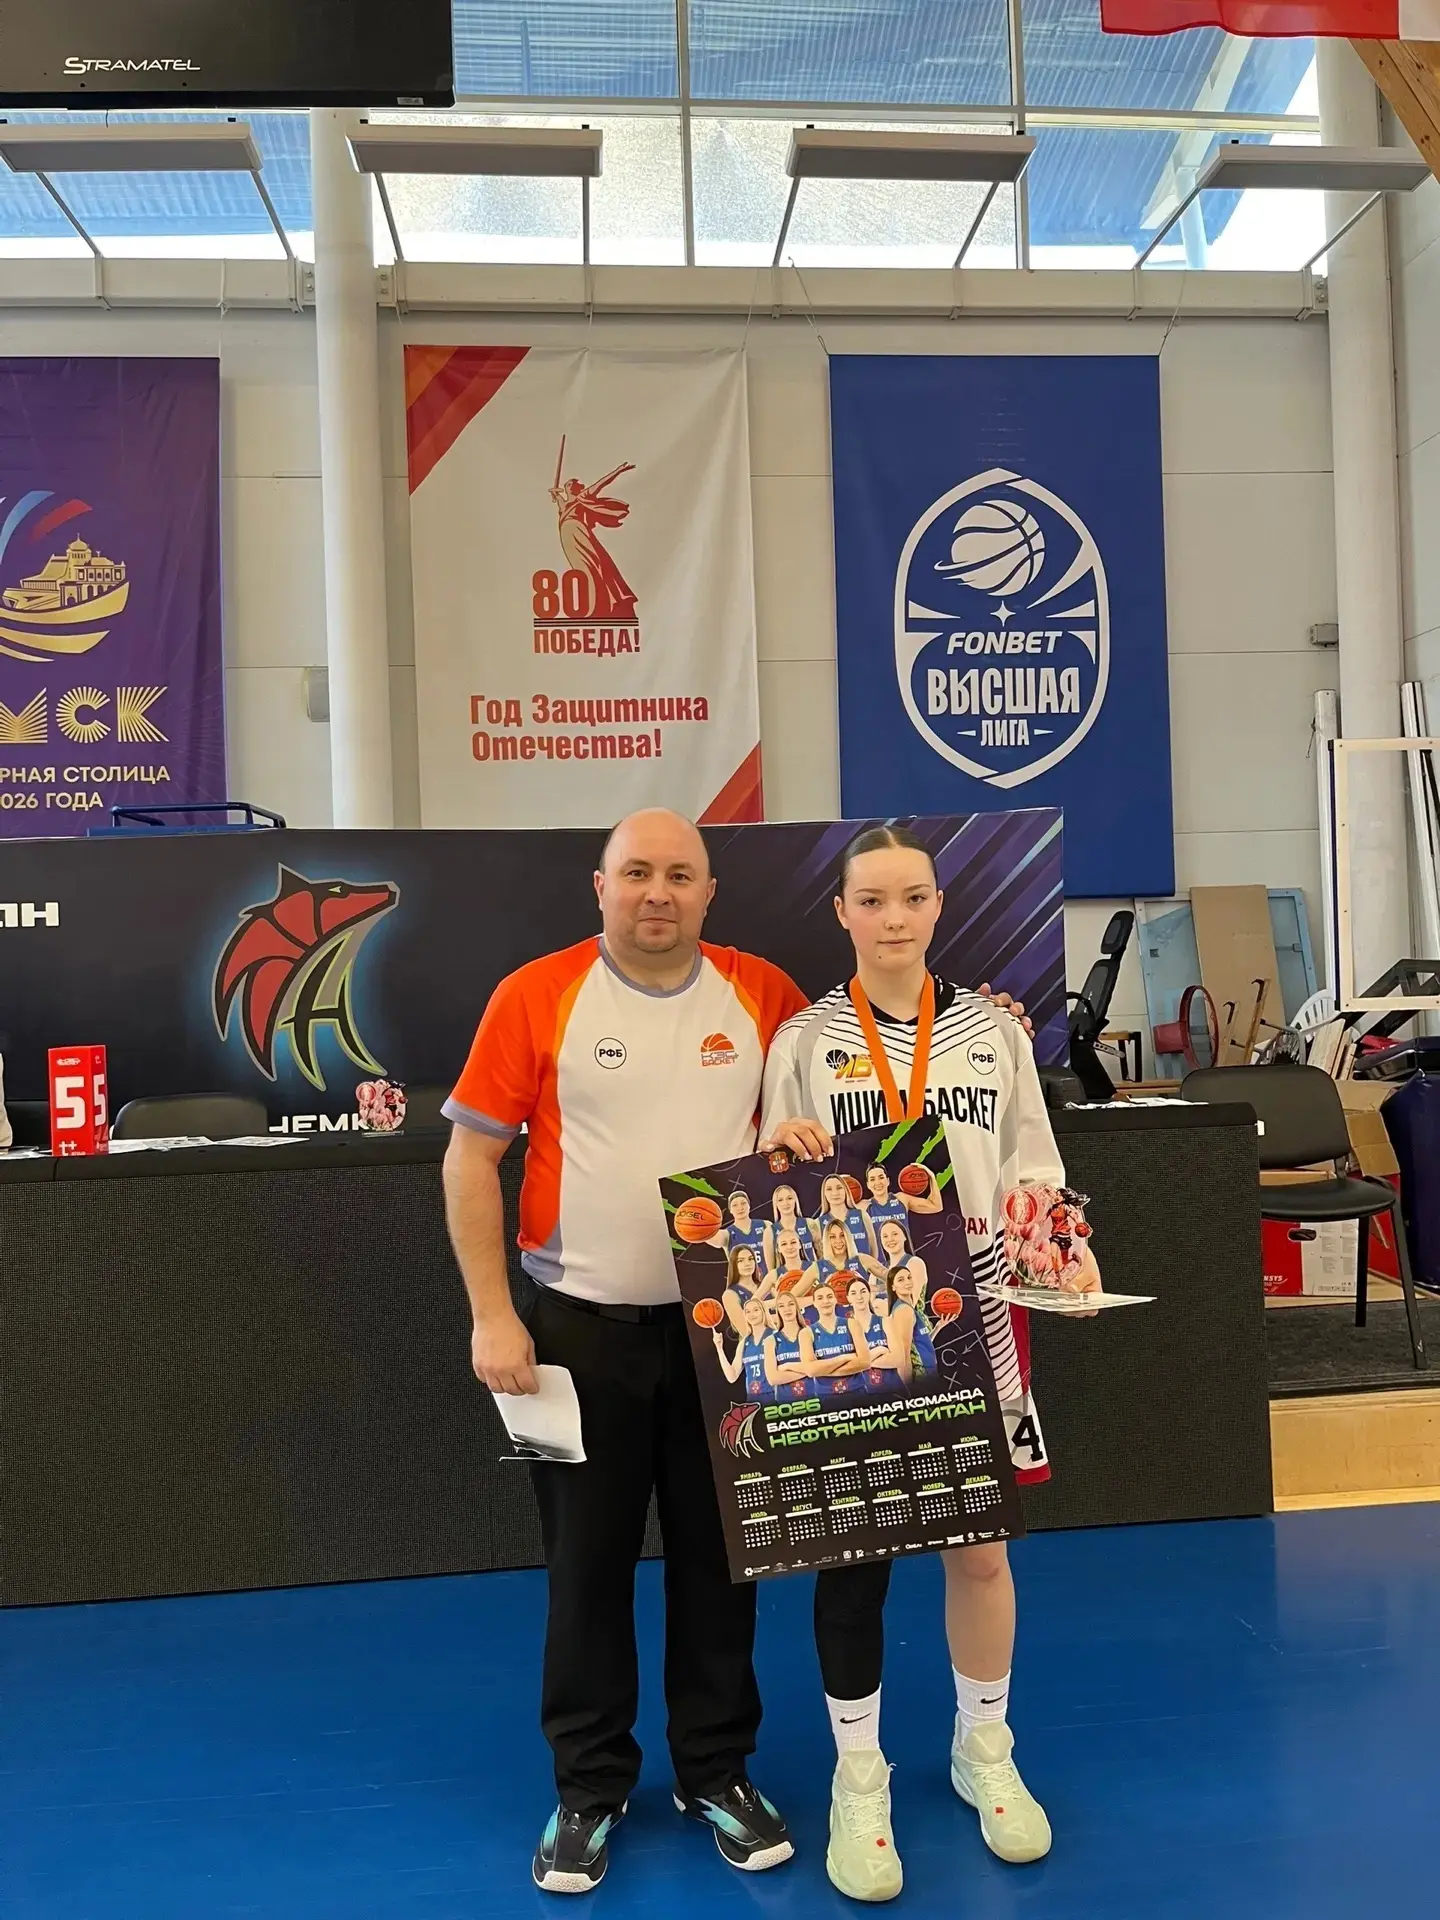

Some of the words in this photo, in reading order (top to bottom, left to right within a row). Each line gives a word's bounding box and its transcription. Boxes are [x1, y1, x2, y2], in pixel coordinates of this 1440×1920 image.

[63, 57, 201, 75] STRAMATEL
[532, 569, 590, 618] 80
[534, 629, 640, 657] ПОБЕДА!
[947, 631, 1063, 655] FONBET
[928, 667, 1080, 715] ВЫСШАЯ
[470, 695, 523, 727] Год
[532, 694, 709, 727] Защитника
[472, 728, 662, 761] Отечества!
[981, 719, 1030, 746] ЛИГА
[0, 767, 56, 783] РНАЯ
[63, 766, 171, 785] СТОЛИЦА
[45, 792, 104, 812] ГОДА
[599, 1048, 623, 1058] РФБ
[972, 1052, 994, 1063] РФБ
[55, 1076, 86, 1129] 5
[93, 1073, 106, 1127] 5
[964, 1217, 988, 1235] АХ
[750, 1364, 761, 1377] 73
[763, 1398, 822, 1420] 2026
[766, 1402, 904, 1433] БАСКЕТБОЛЬНАЯ
[905, 1387, 985, 1411] КОМАНДА
[768, 1399, 988, 1449] НЕФТЯНИК-ТИТАН
[1011, 1414, 1044, 1462] 4
[830, 1457, 846, 1465] МАРТ
[792, 1503, 813, 1512] АВГУСТ
